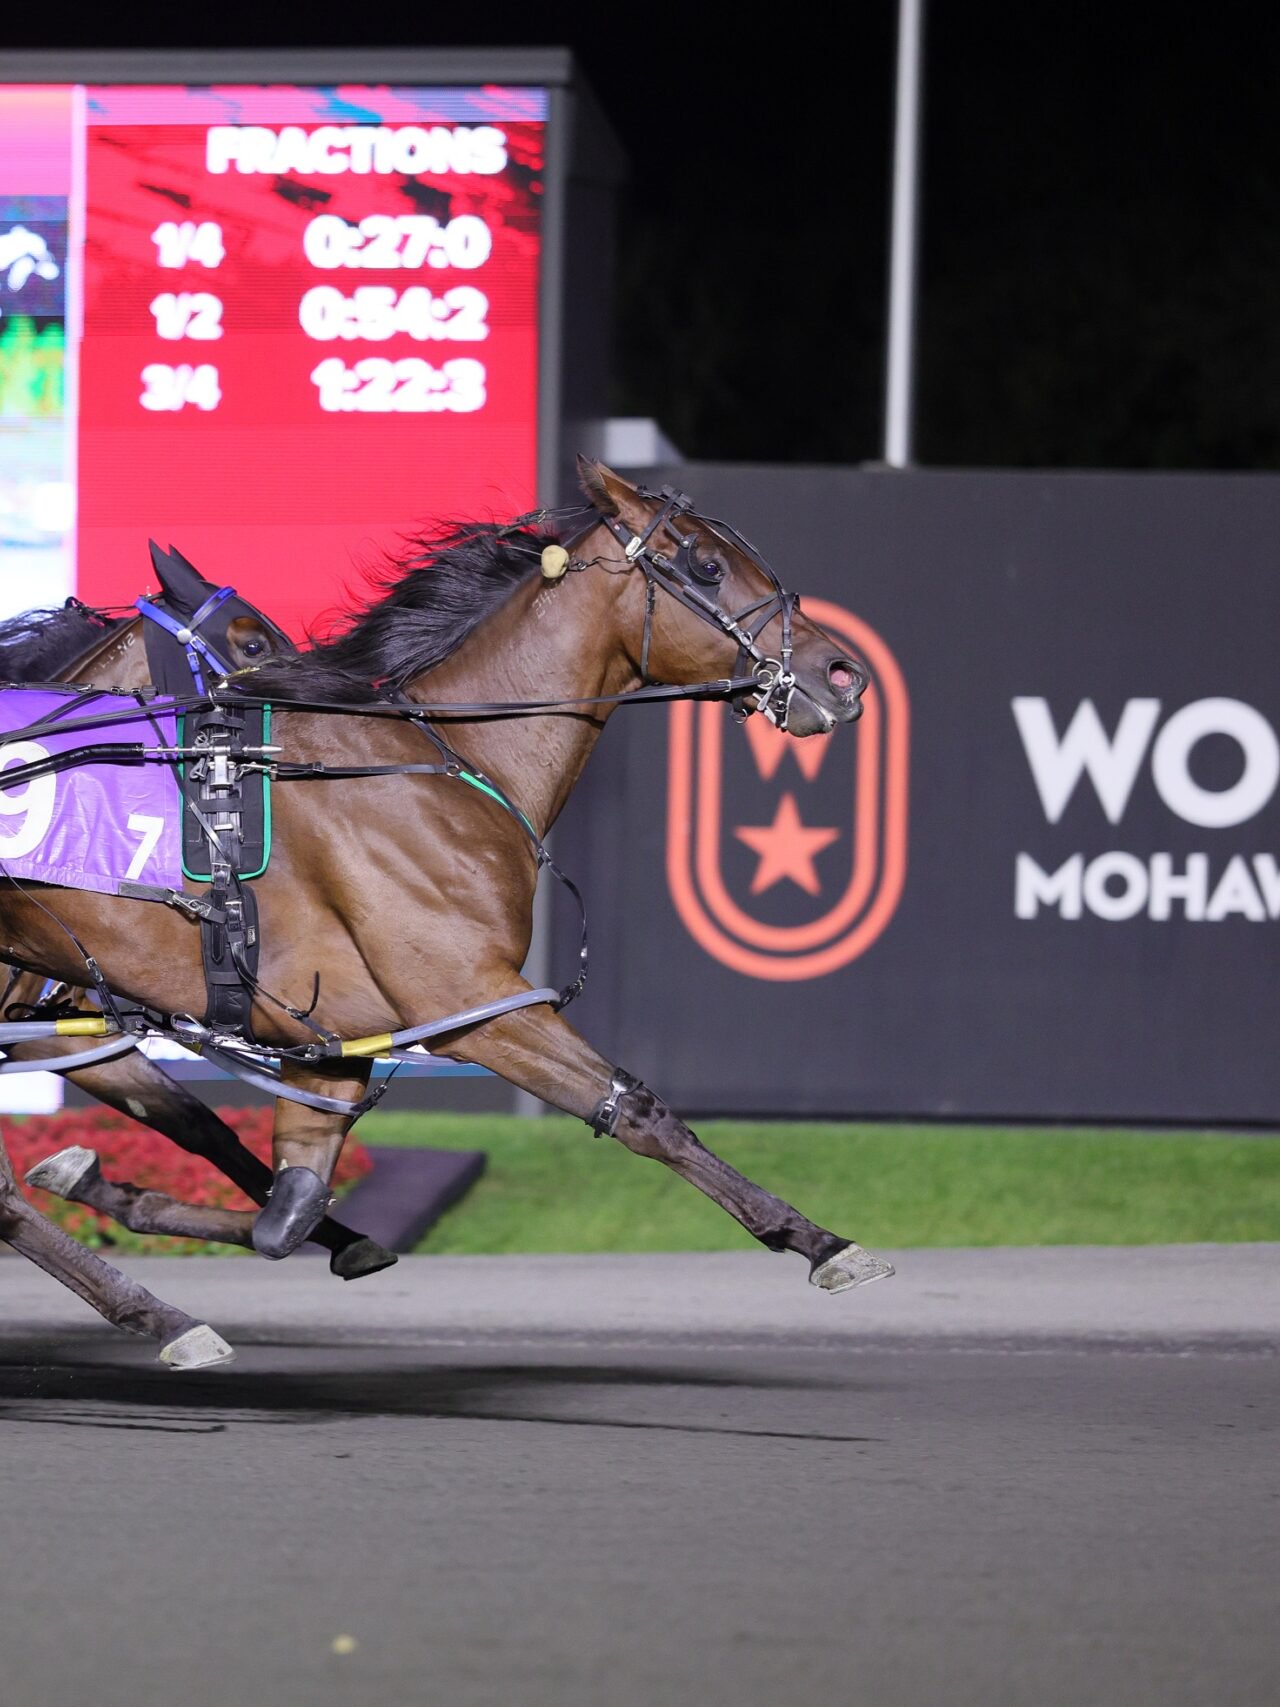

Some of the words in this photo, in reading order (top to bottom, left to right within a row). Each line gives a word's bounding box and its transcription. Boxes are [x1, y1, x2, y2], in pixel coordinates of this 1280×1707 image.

[207, 127, 506, 174] FRACTIONS
[154, 223, 224, 267] 1/4
[304, 216, 491, 268] 0:27:0
[152, 293, 221, 339] 1/2
[300, 286, 488, 341] 0:54:2
[141, 364, 220, 411] 3/4
[312, 358, 485, 412] 1:22:3
[1012, 696, 1280, 828] WO
[124, 813, 165, 880] 7
